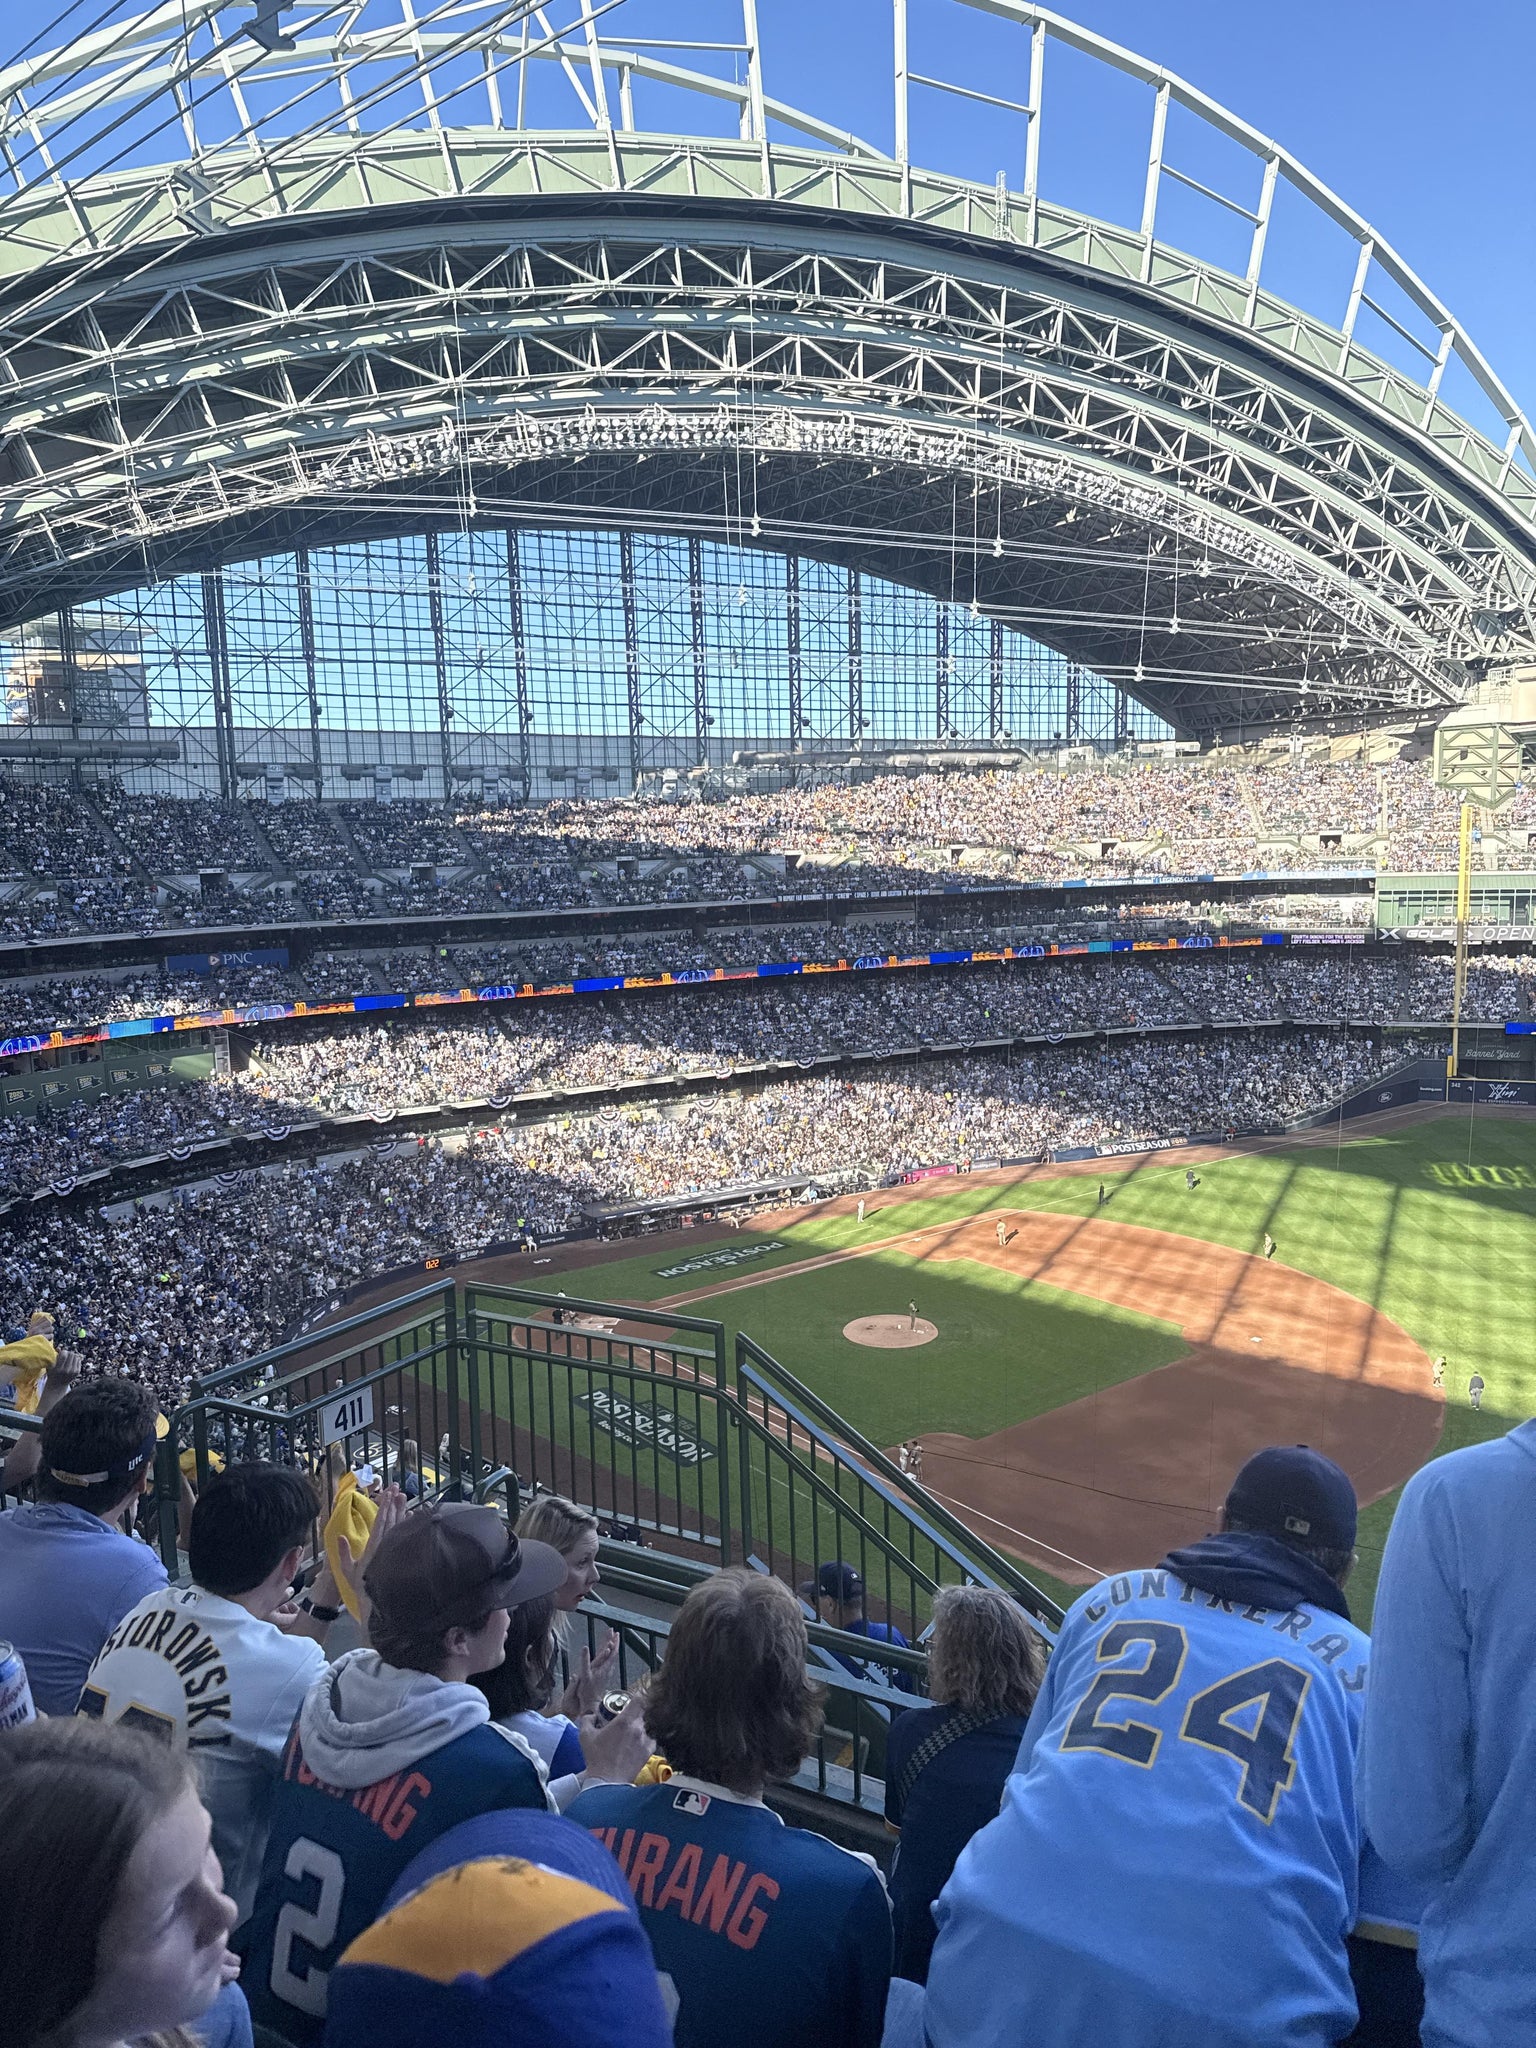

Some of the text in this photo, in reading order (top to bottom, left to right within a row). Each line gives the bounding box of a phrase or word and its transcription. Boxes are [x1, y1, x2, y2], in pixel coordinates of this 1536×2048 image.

[968, 885, 1004, 893] Northwestern
[1092, 878, 1132, 887] Northwestern
[1133, 877, 1155, 885] Mutual
[1406, 929, 1455, 938] GOLF
[1483, 927, 1535, 940] OPEN
[223, 952, 253, 965] PNC
[1465, 1049, 1521, 1060] Barrel Yard
[1112, 1138, 1170, 1154] POSTSEASON
[657, 1241, 785, 1278] POSTSEASON
[334, 1396, 363, 1431] 411
[1059, 1620, 1313, 1827] 24
[270, 1836, 347, 2018] 2
